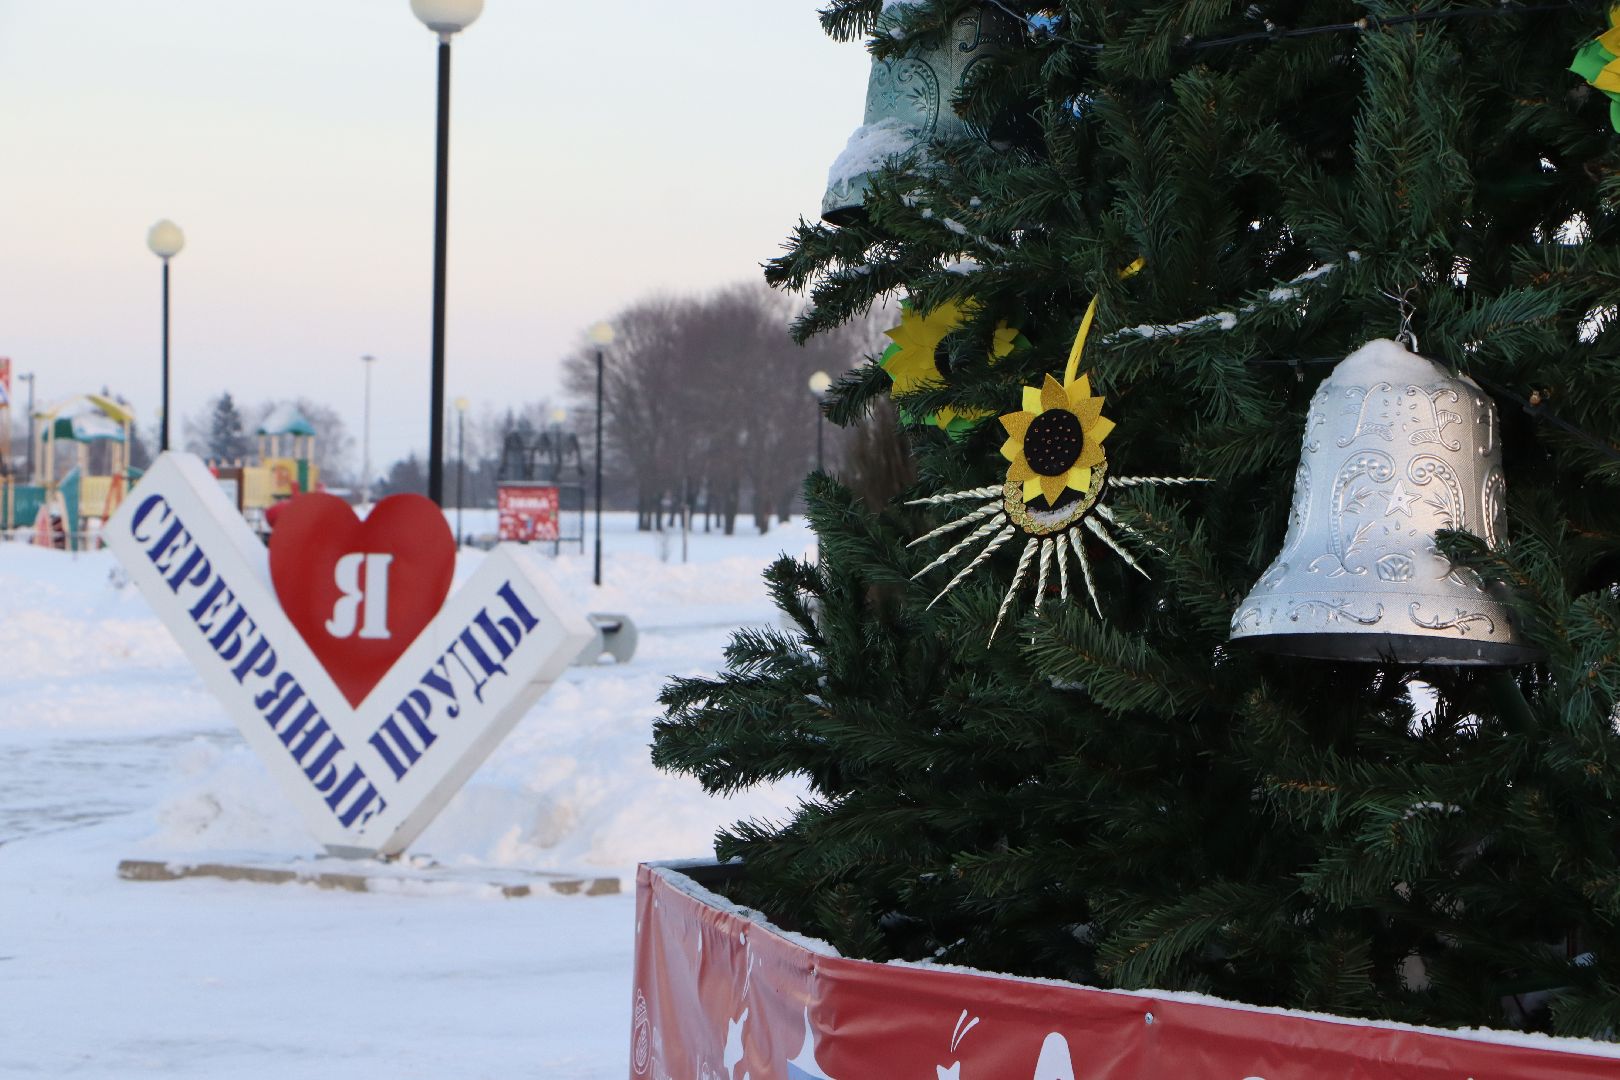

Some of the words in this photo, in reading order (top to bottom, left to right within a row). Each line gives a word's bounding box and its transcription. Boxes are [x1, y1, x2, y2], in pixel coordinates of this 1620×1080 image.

[130, 494, 387, 833] СЕРЕБРЯНЫЕ
[325, 552, 393, 639] Я
[367, 579, 540, 782] ПРУДЫ
